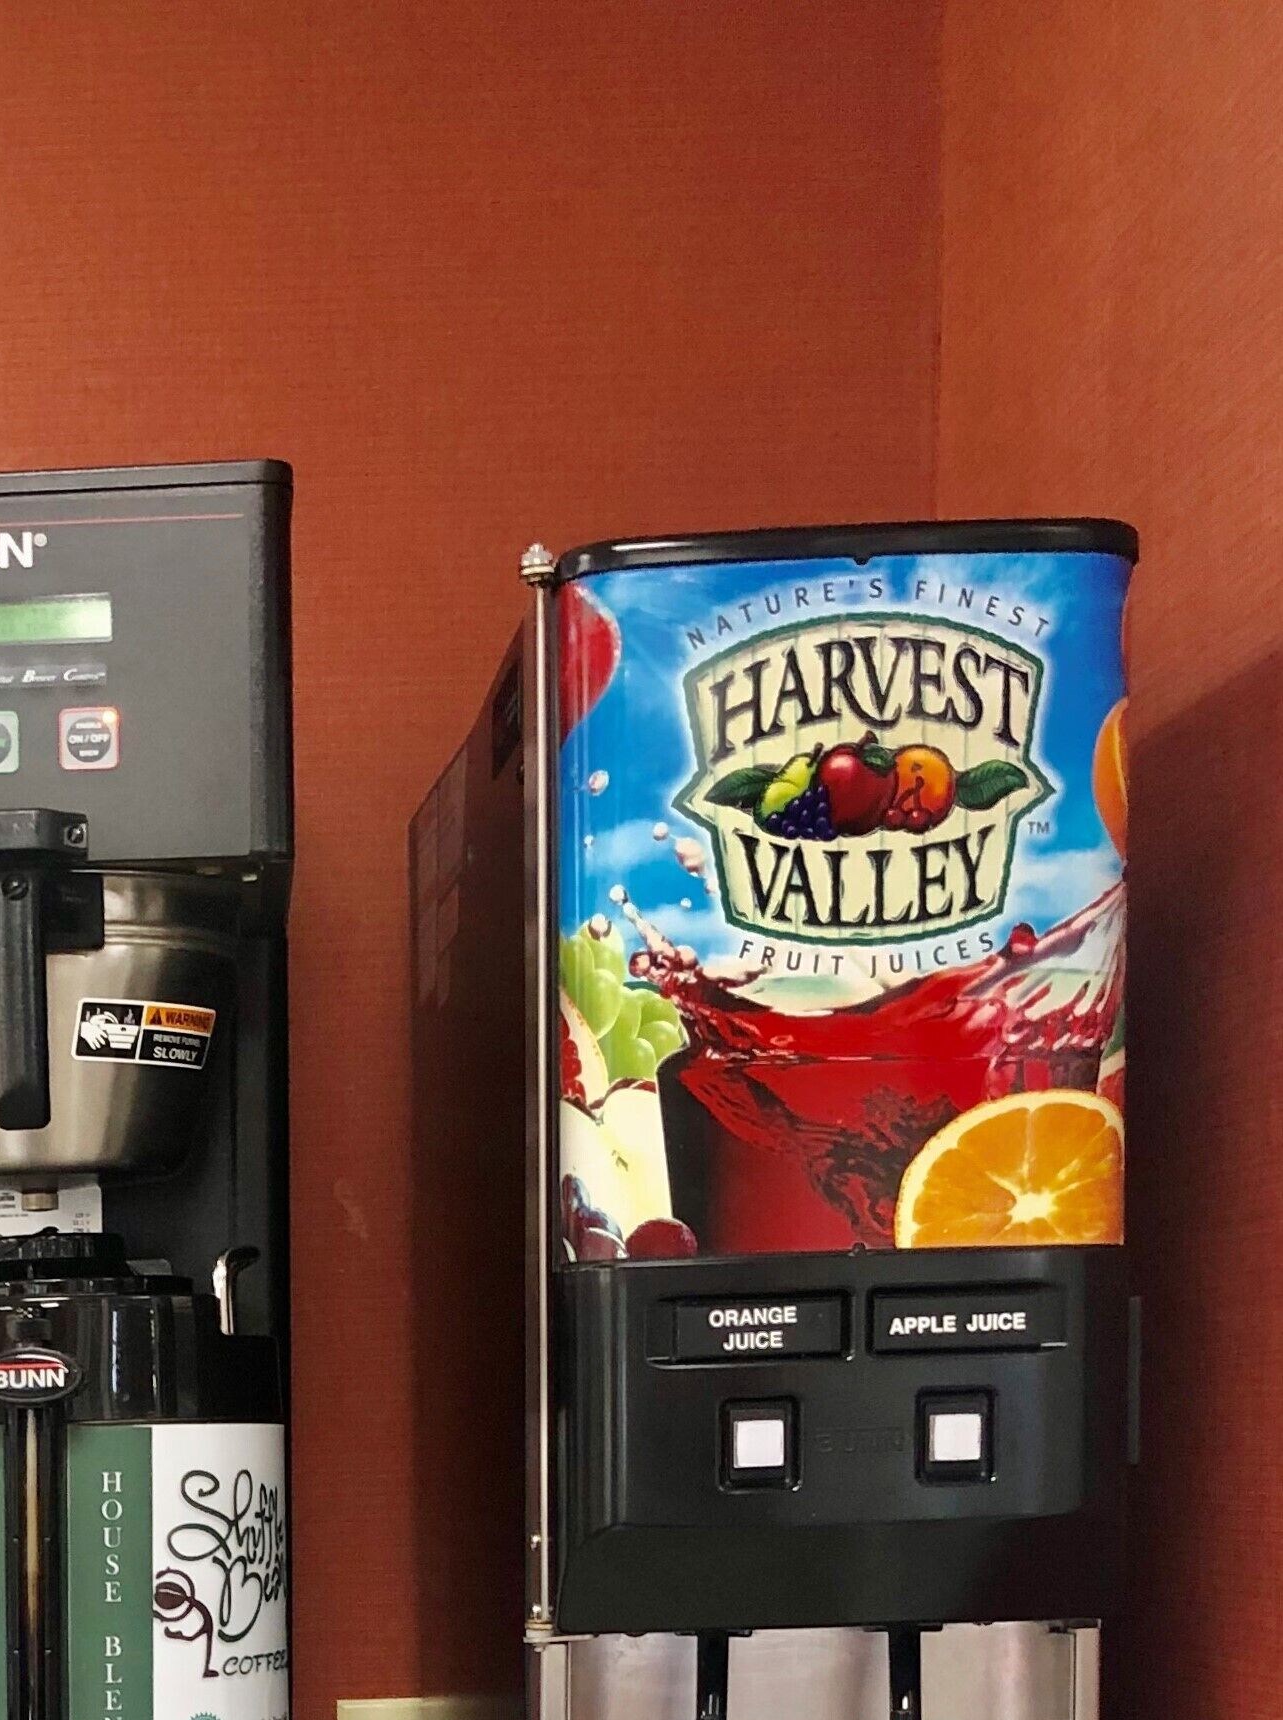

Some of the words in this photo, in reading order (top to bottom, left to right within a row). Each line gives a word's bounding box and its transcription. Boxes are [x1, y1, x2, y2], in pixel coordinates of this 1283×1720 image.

[687, 577, 884, 647] NATURE'S
[915, 580, 1051, 638] FINEST
[708, 633, 1032, 762] HARVEST
[735, 825, 996, 927] VALLEY
[739, 940, 843, 977] FRUIT
[870, 931, 995, 979] JUICES
[153, 1046, 198, 1061] SLOWLY
[709, 1306, 798, 1327] ORANGE
[889, 1315, 957, 1336] APPLE
[966, 1312, 1027, 1332] JUICE
[723, 1331, 783, 1351] JUICE
[101, 1472, 124, 1603] HOUSE
